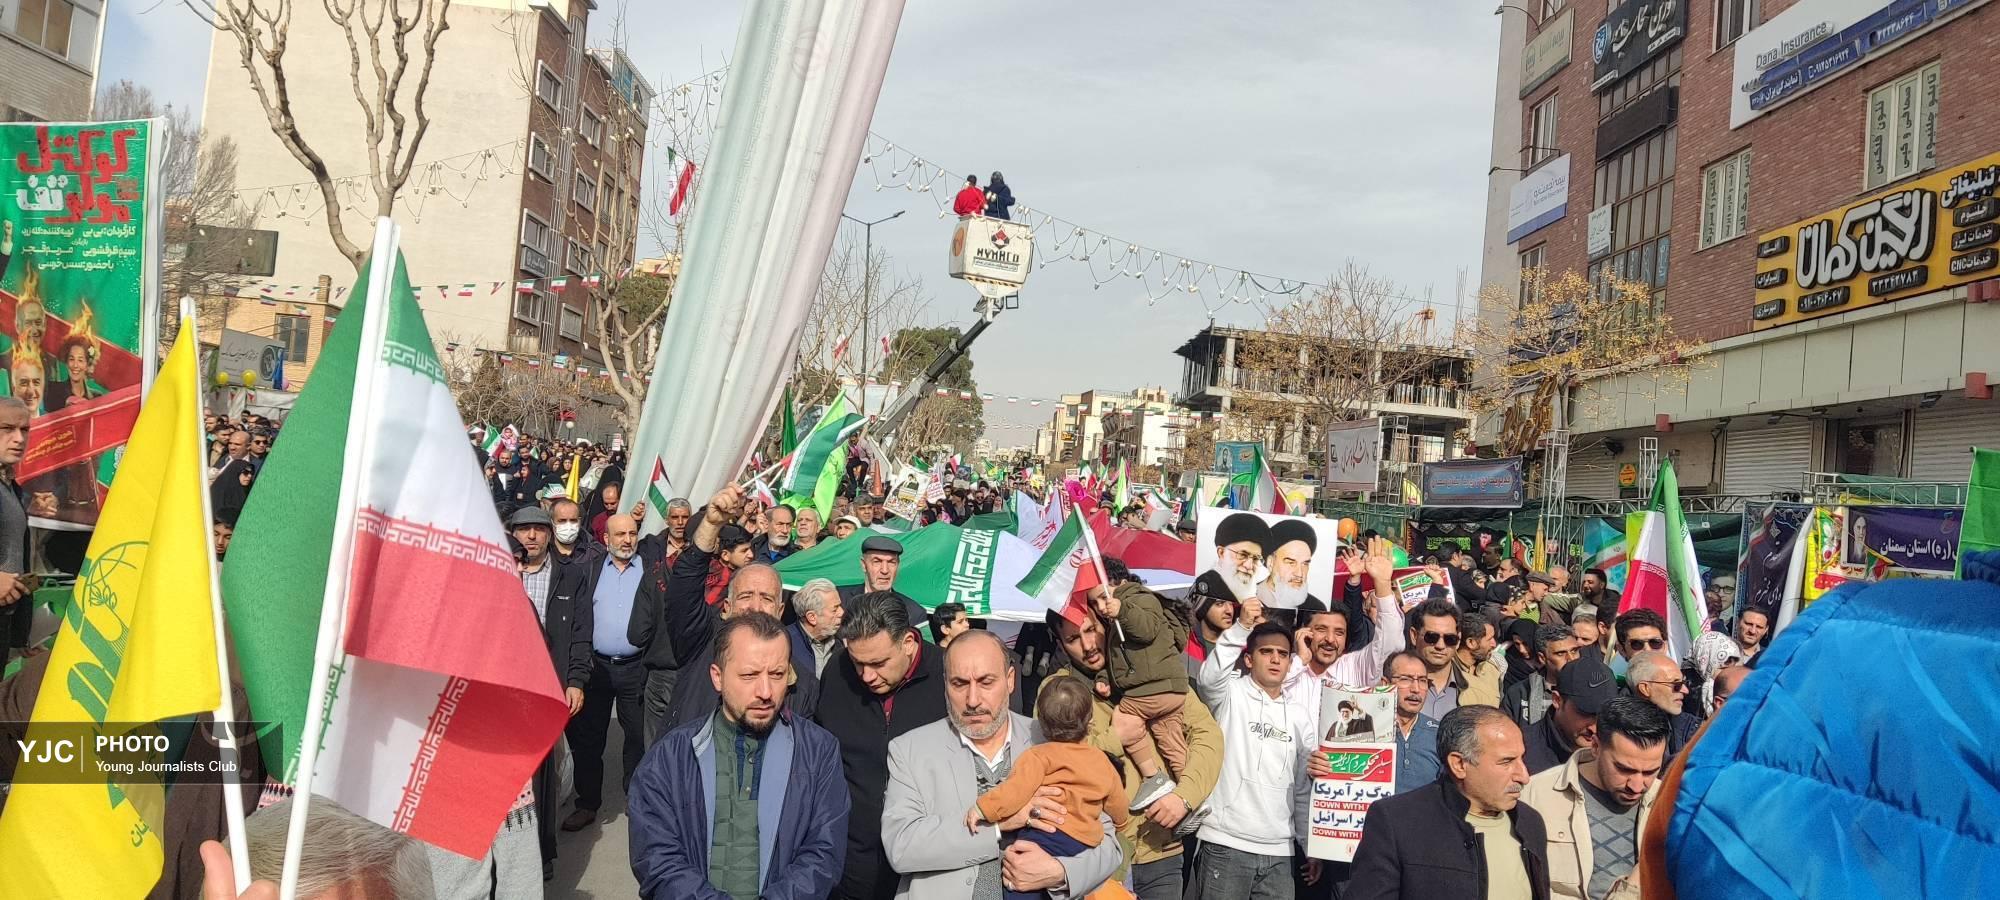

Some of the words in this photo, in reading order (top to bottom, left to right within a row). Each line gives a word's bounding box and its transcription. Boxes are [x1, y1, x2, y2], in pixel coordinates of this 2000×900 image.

[1755, 47, 1778, 70] Dana
[1780, 21, 1828, 54] Insurance
[17, 126, 136, 183] کوکتل
[1942, 166, 1995, 207] تبلیغاتی
[1880, 537, 1906, 556] سمنان
[1907, 538, 1930, 558] استان
[1315, 782, 1353, 799] آمریکا
[1352, 788, 1364, 801] بر
[1366, 785, 1392, 799] مرگ
[1314, 800, 1340, 809] DOWN
[1342, 802, 1365, 811] WITH
[1313, 810, 1353, 827] اسرائیل
[1313, 828, 1337, 836] DOWN
[1339, 830, 1359, 839] WITH
